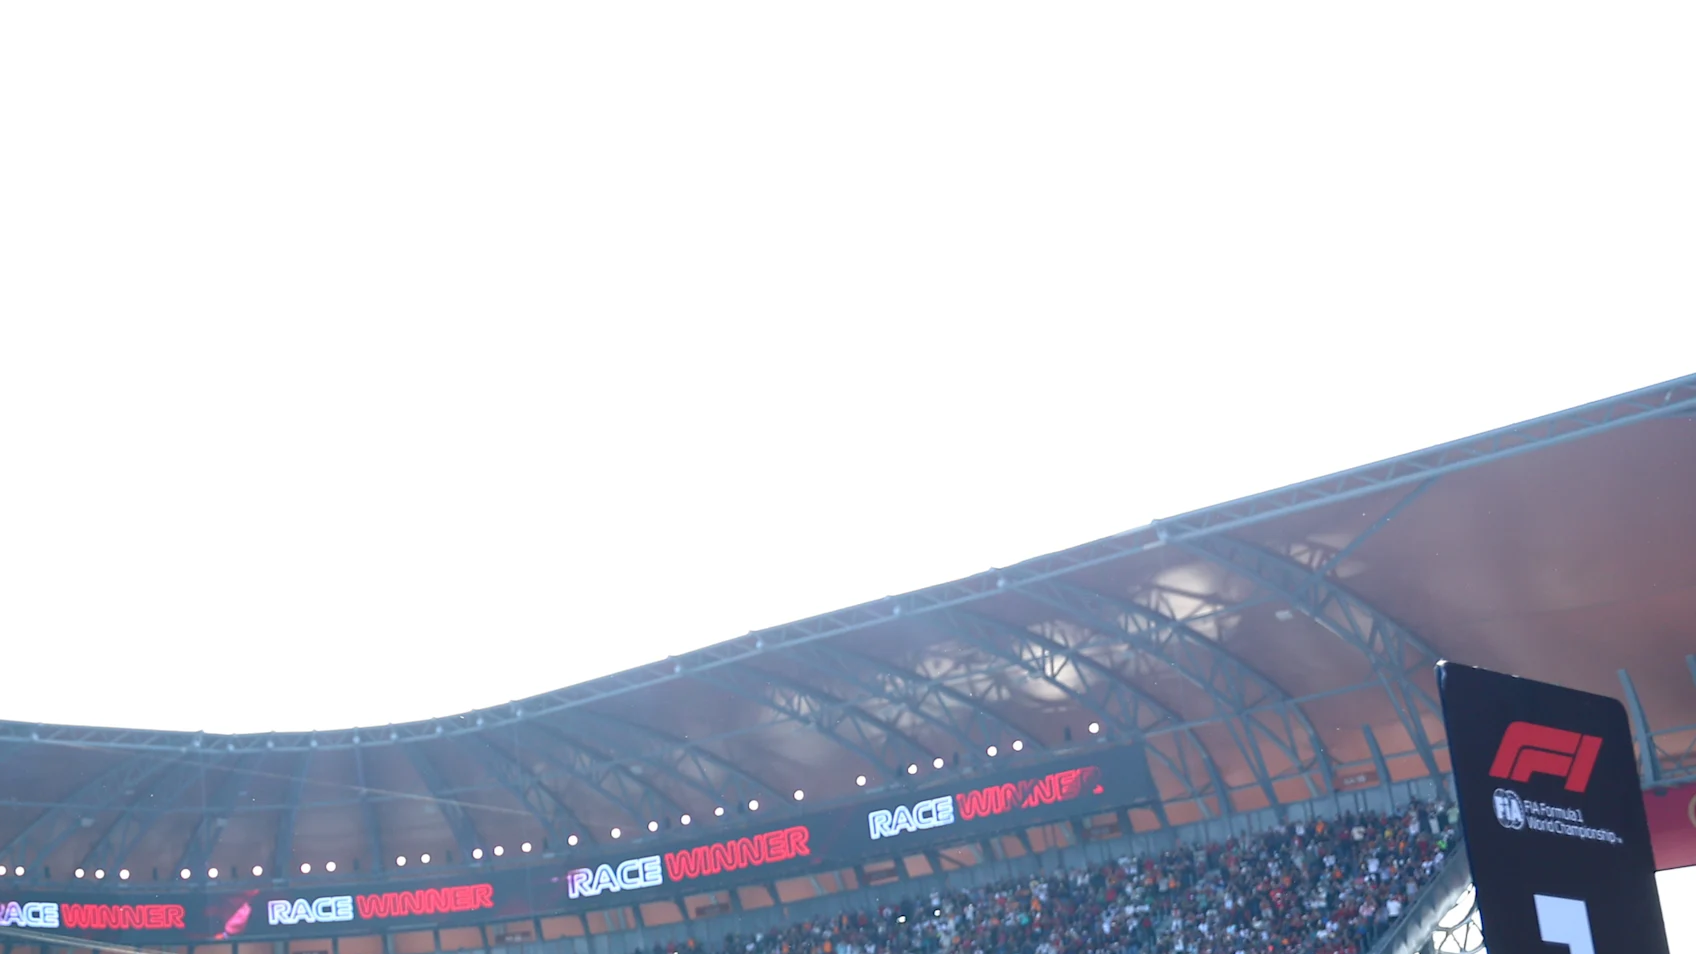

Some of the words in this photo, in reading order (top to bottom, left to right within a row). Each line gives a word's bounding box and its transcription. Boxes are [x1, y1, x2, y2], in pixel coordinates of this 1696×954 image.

[868, 796, 954, 839] RACE
[1526, 816, 1554, 833] World
[1540, 803, 1578, 822] Formula
[568, 856, 663, 899] RACE
[665, 825, 810, 882] WINNER
[60, 903, 185, 929] WINNER
[267, 896, 355, 926] RACE
[356, 883, 494, 919] WINNER
